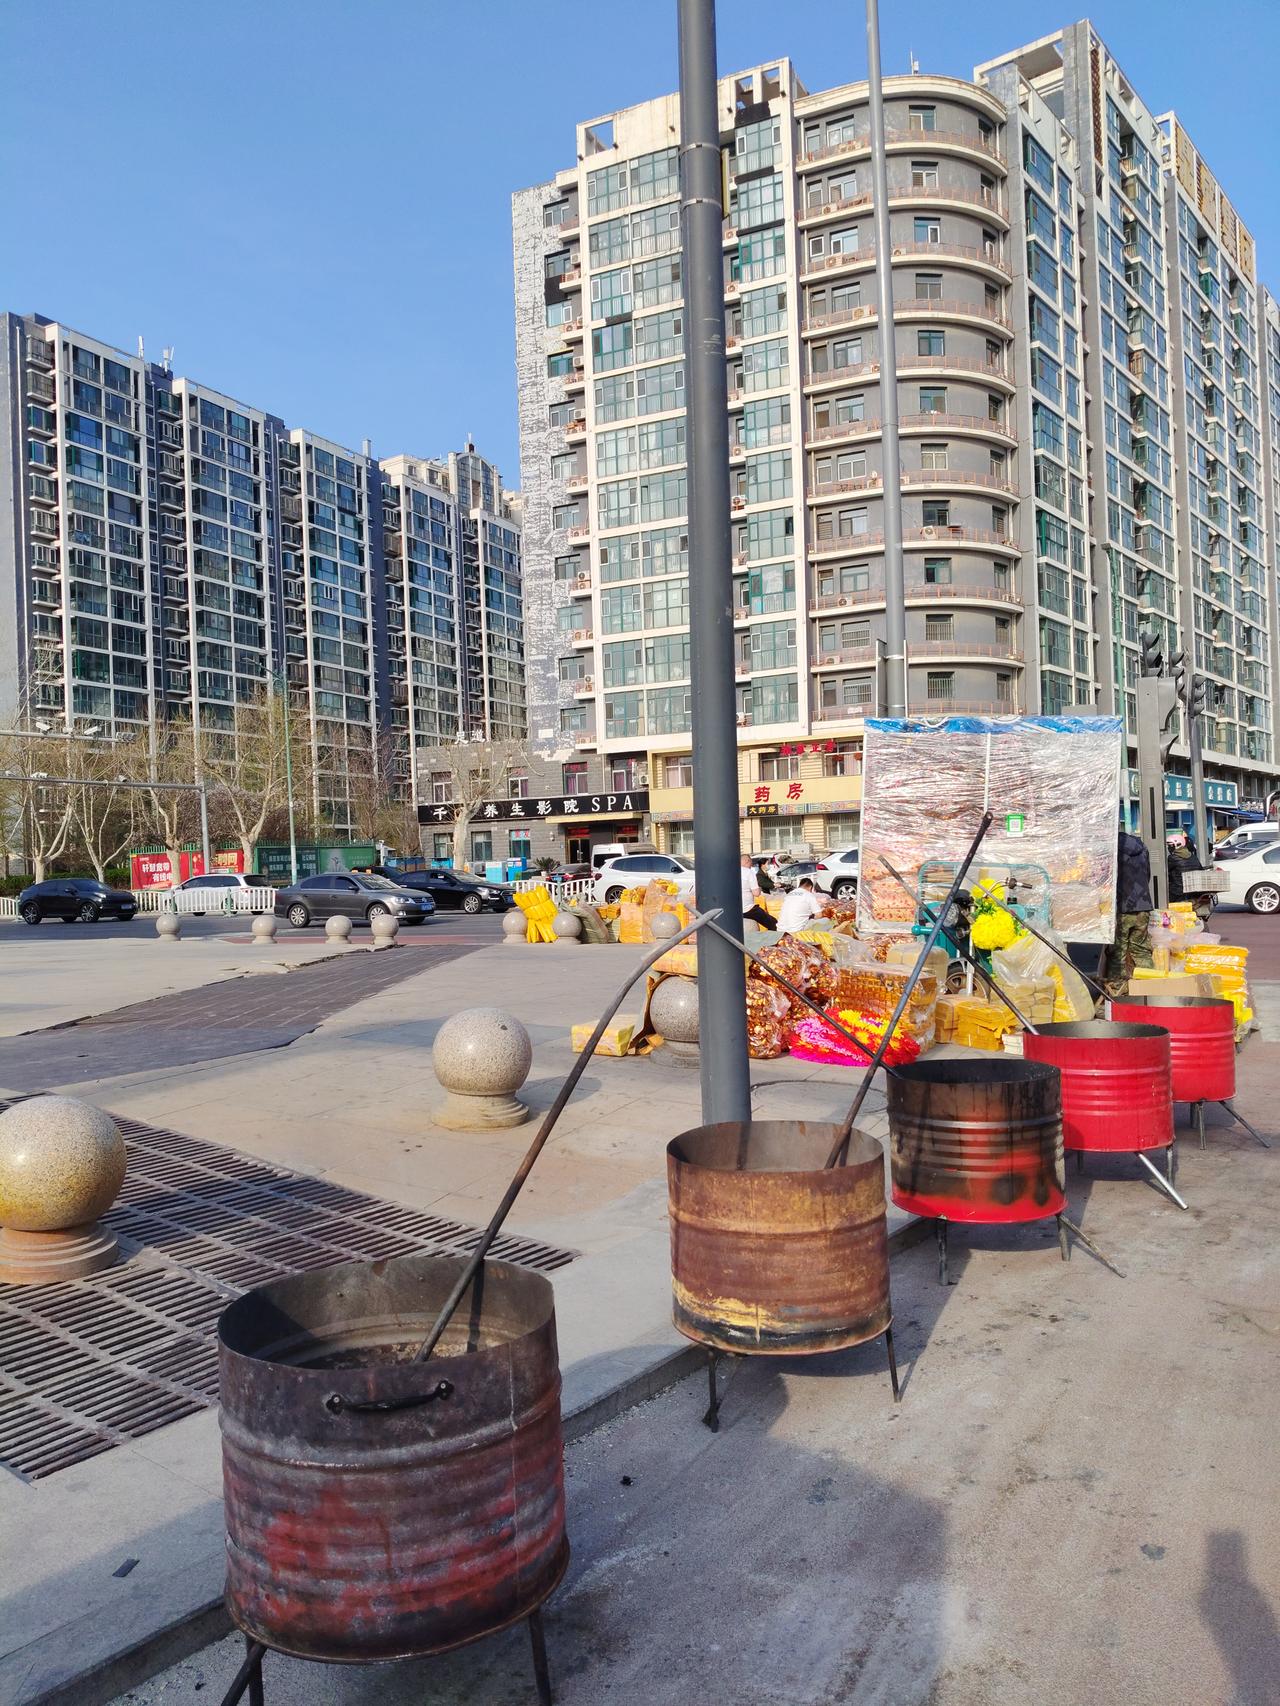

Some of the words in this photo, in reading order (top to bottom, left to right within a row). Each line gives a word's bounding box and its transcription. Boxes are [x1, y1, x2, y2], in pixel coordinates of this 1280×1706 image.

[754, 782, 804, 803] 药房
[433, 799, 579, 821] 千养生影院
[591, 795, 633, 812] SPA
